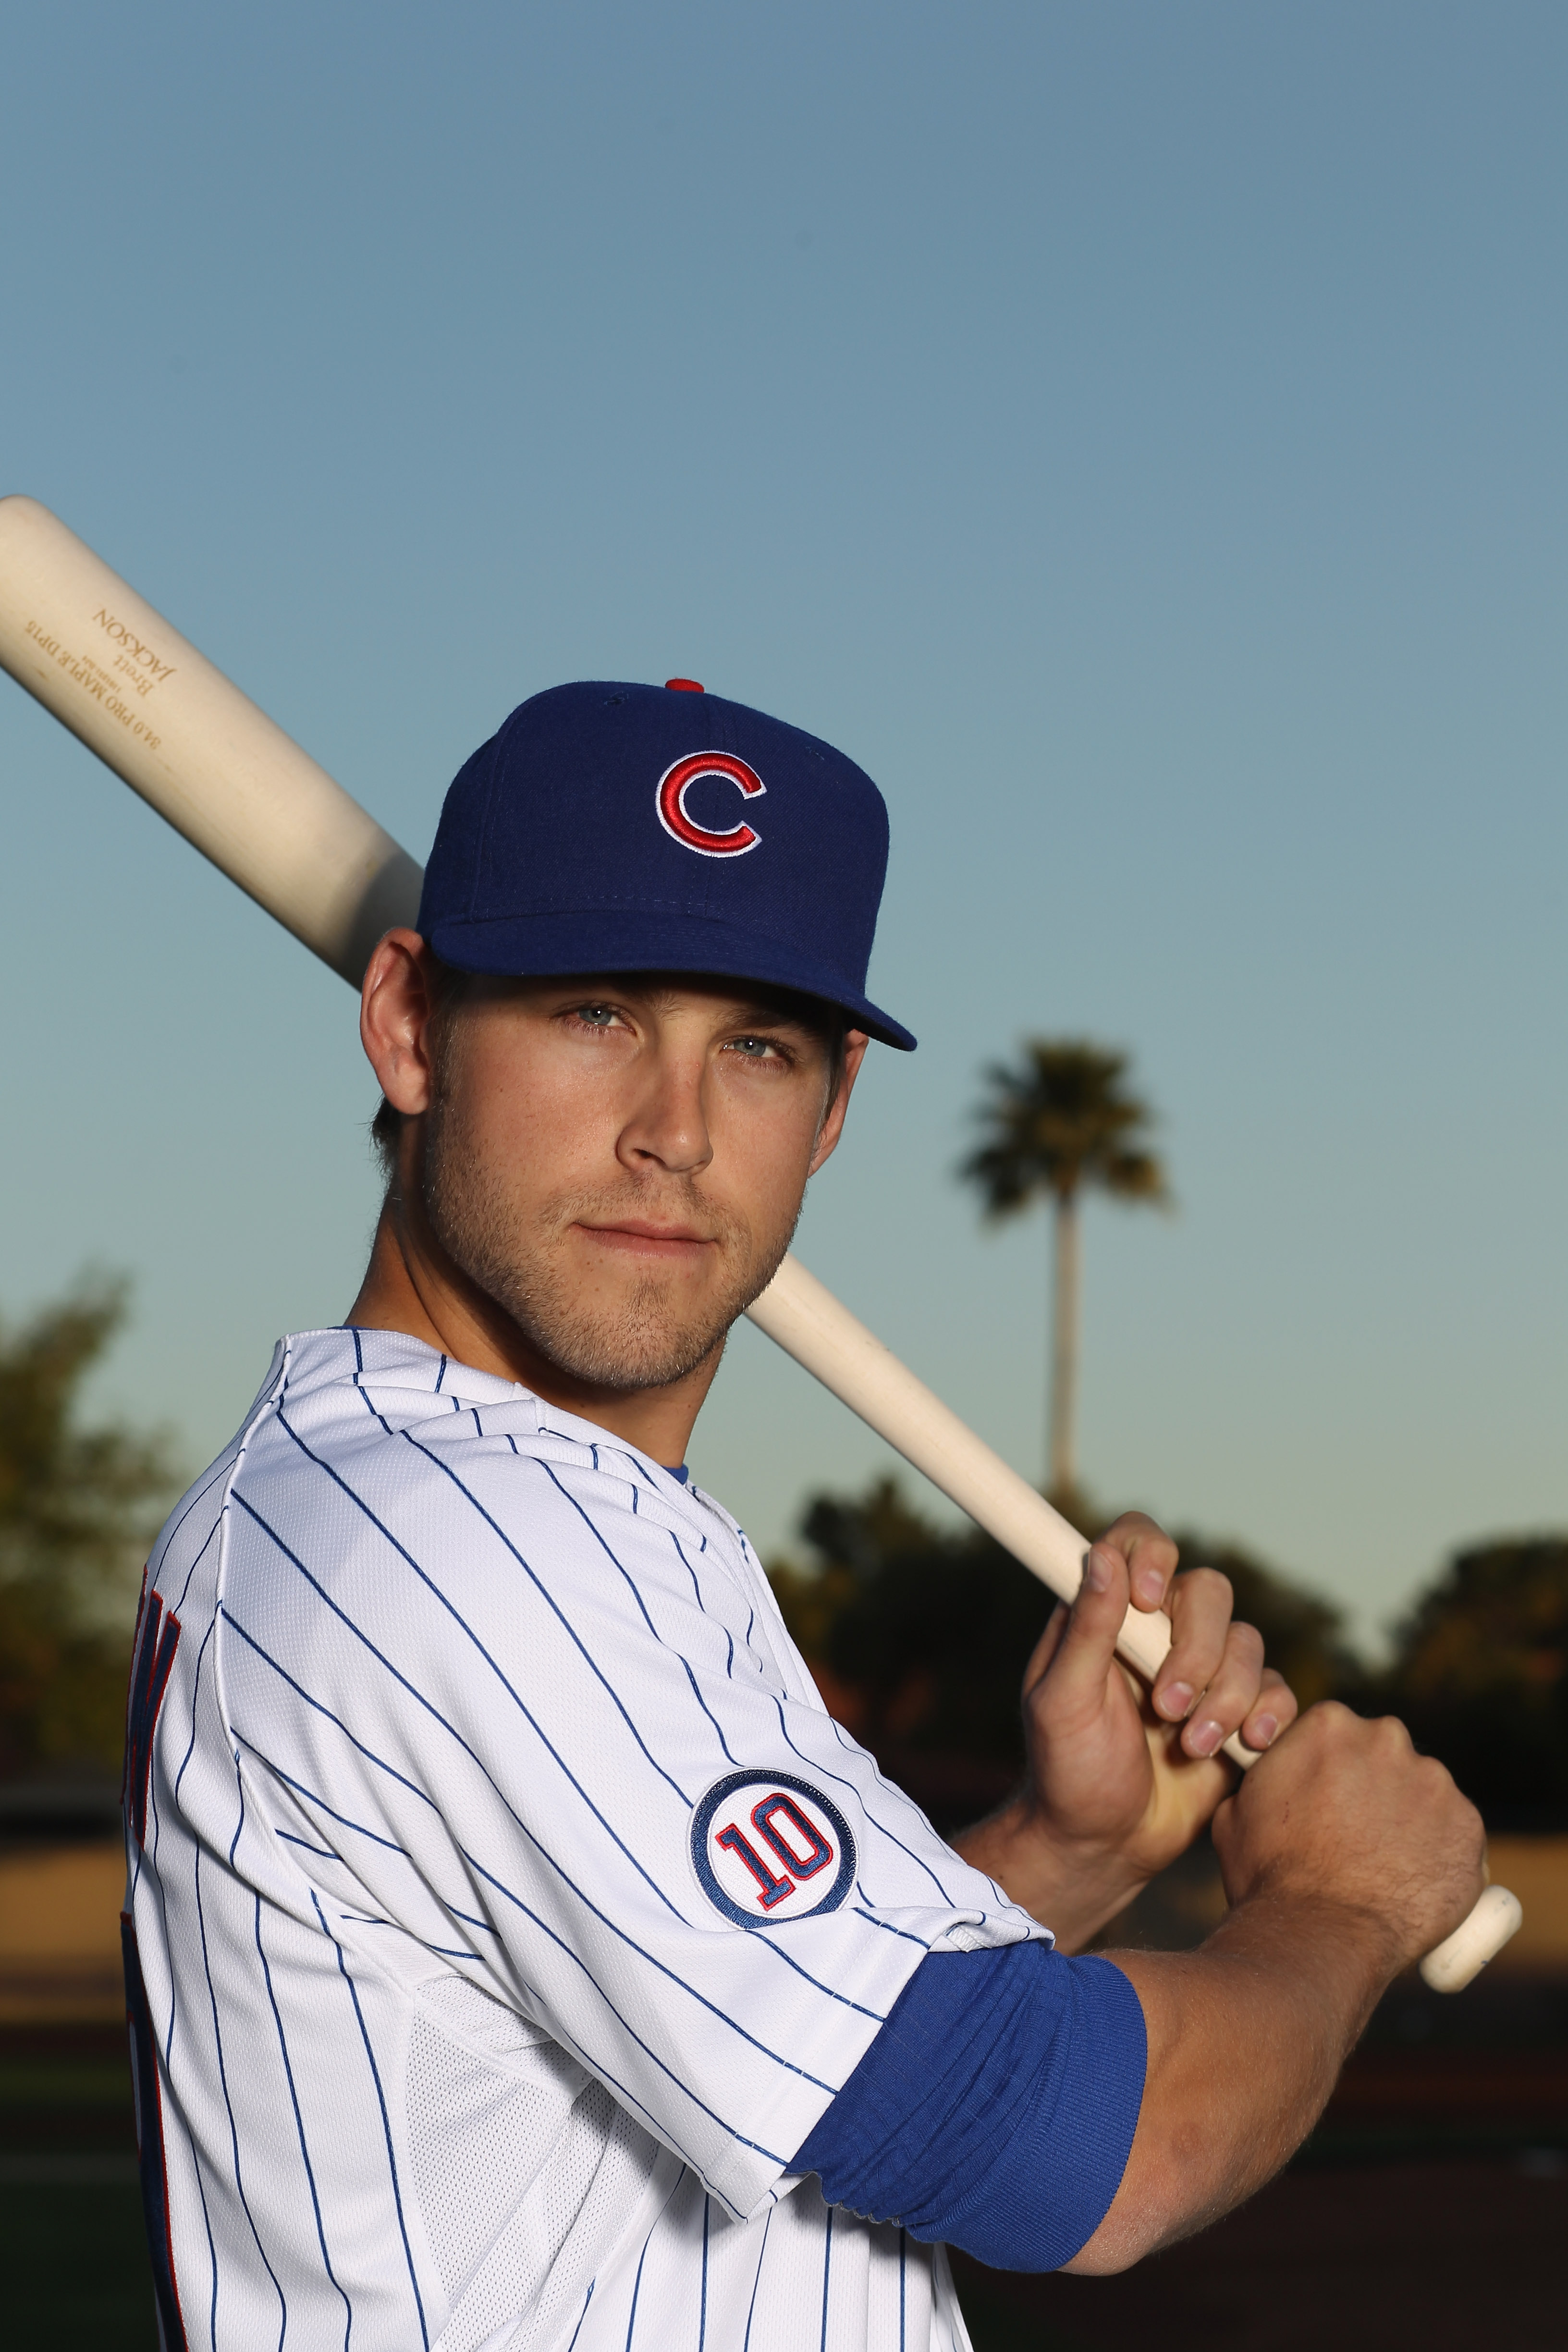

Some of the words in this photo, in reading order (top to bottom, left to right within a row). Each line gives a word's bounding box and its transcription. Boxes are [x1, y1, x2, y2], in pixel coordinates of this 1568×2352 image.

[25, 620, 61, 656] DP15
[92, 608, 177, 682] JACKSON
[57, 650, 107, 700] MAPLE
[113, 654, 154, 696] Brett
[105, 696, 135, 726] PRO
[133, 722, 161, 749] 34.0
[655, 749, 768, 858] C
[715, 1792, 833, 1911] 10
